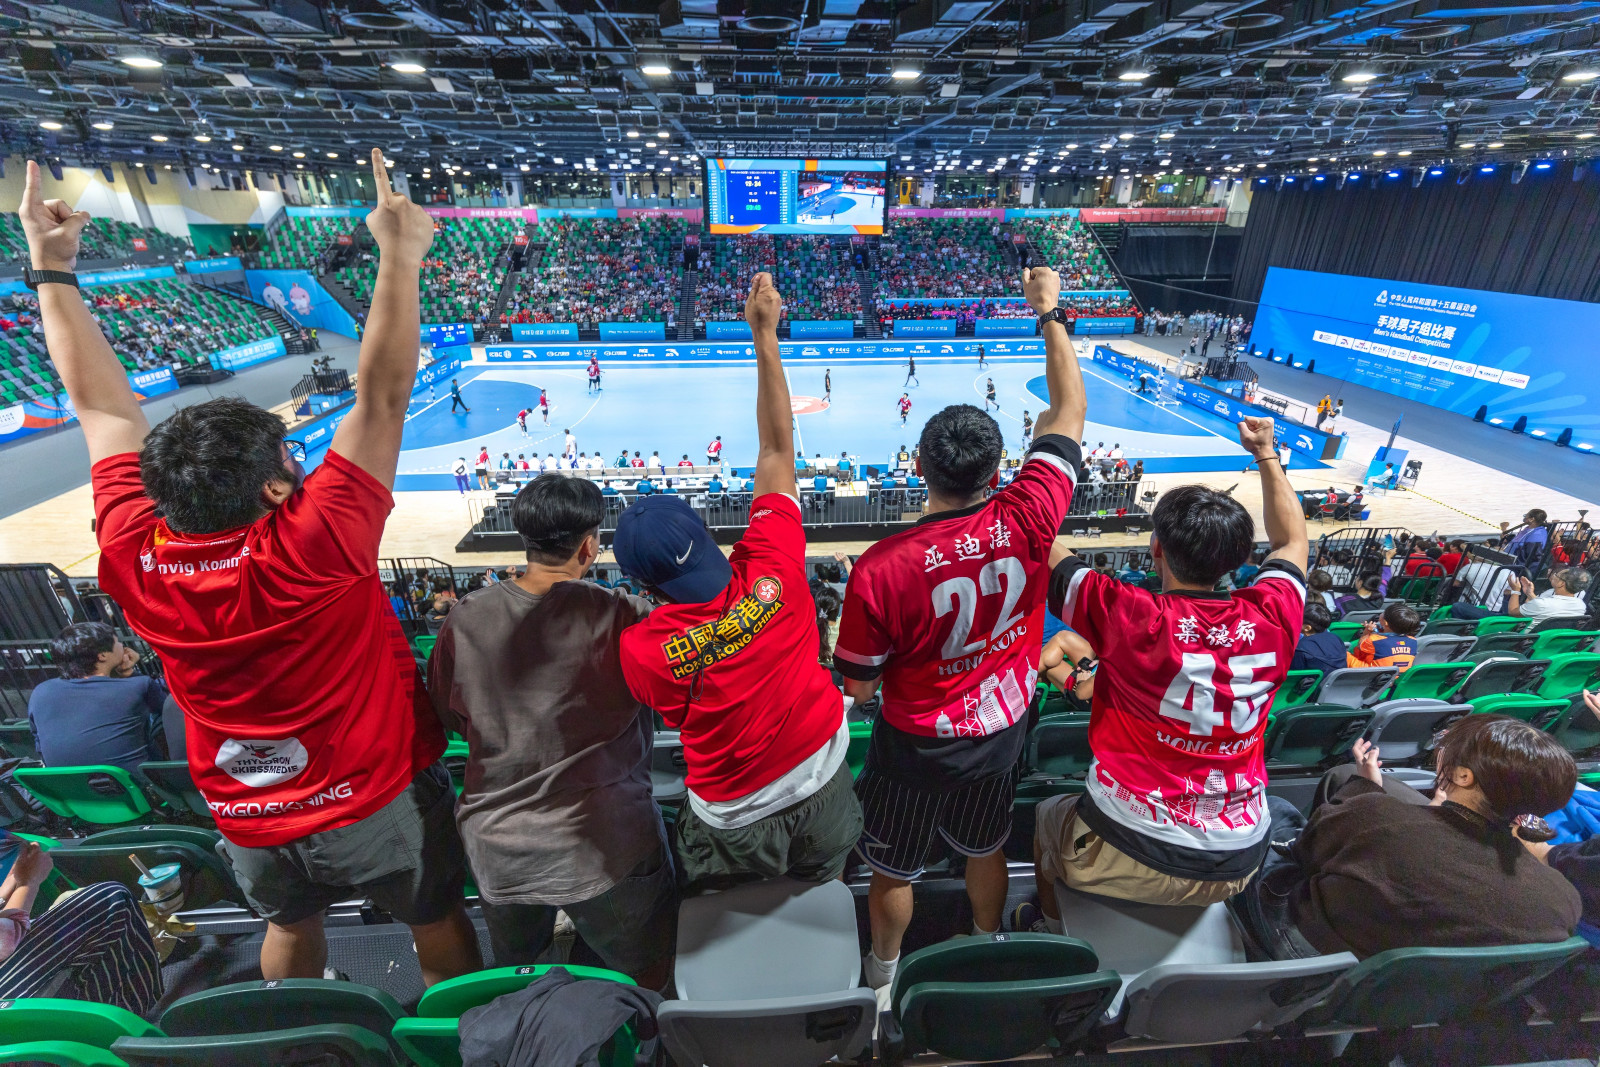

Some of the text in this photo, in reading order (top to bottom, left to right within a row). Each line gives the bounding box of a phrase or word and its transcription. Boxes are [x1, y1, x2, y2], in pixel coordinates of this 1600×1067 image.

[1377, 315, 1457, 340] 手球男子组比赛
[1390, 332, 1415, 342] Handball
[1414, 335, 1451, 349] Competition
[752, 601, 783, 634] CHINA
[931, 556, 1027, 661] 22
[665, 596, 764, 663] 中國香港
[1158, 651, 1277, 737] 45
[231, 765, 298, 774] SKIBSSMEDIE
